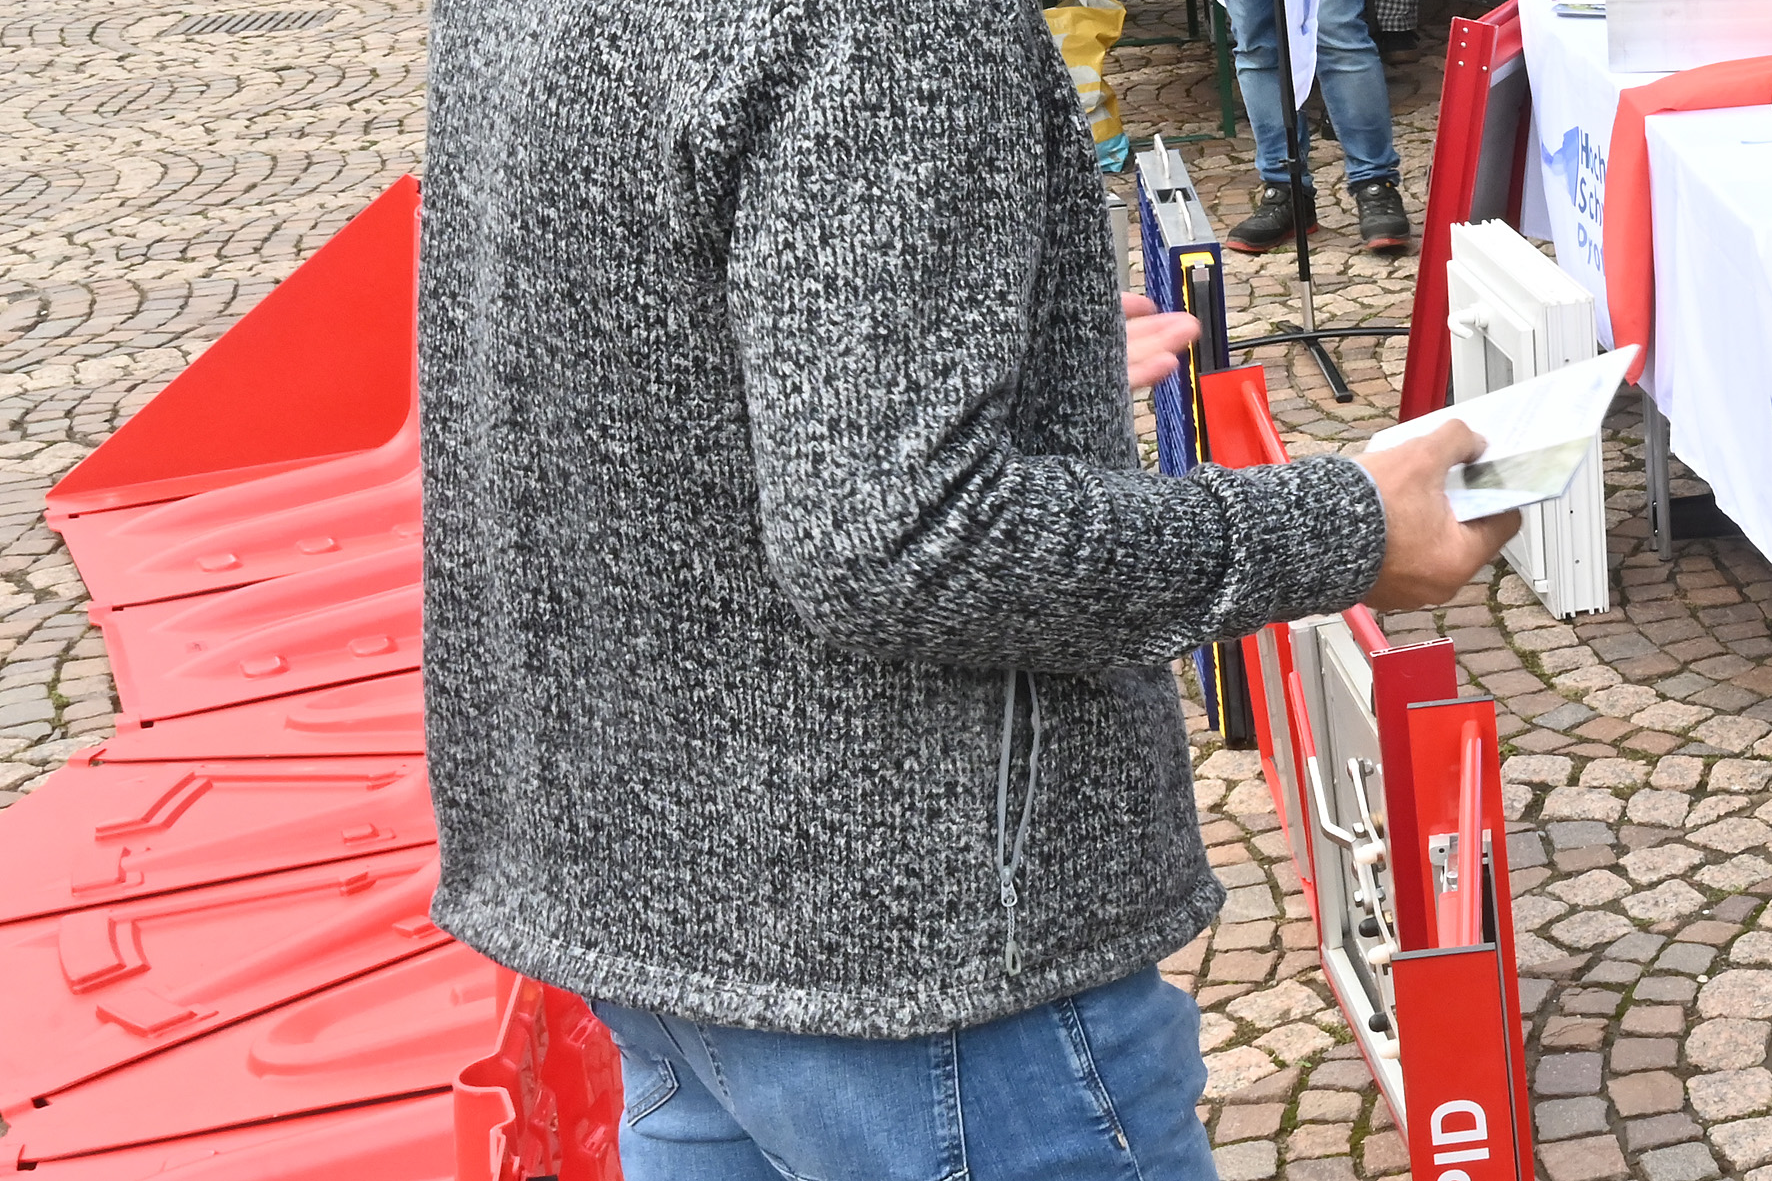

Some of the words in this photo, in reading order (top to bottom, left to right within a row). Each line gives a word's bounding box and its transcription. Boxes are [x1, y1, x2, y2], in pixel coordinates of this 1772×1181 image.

[1578, 177, 1604, 226] Sch
[1577, 222, 1606, 277] Pro
[1430, 1099, 1490, 1181] ID
